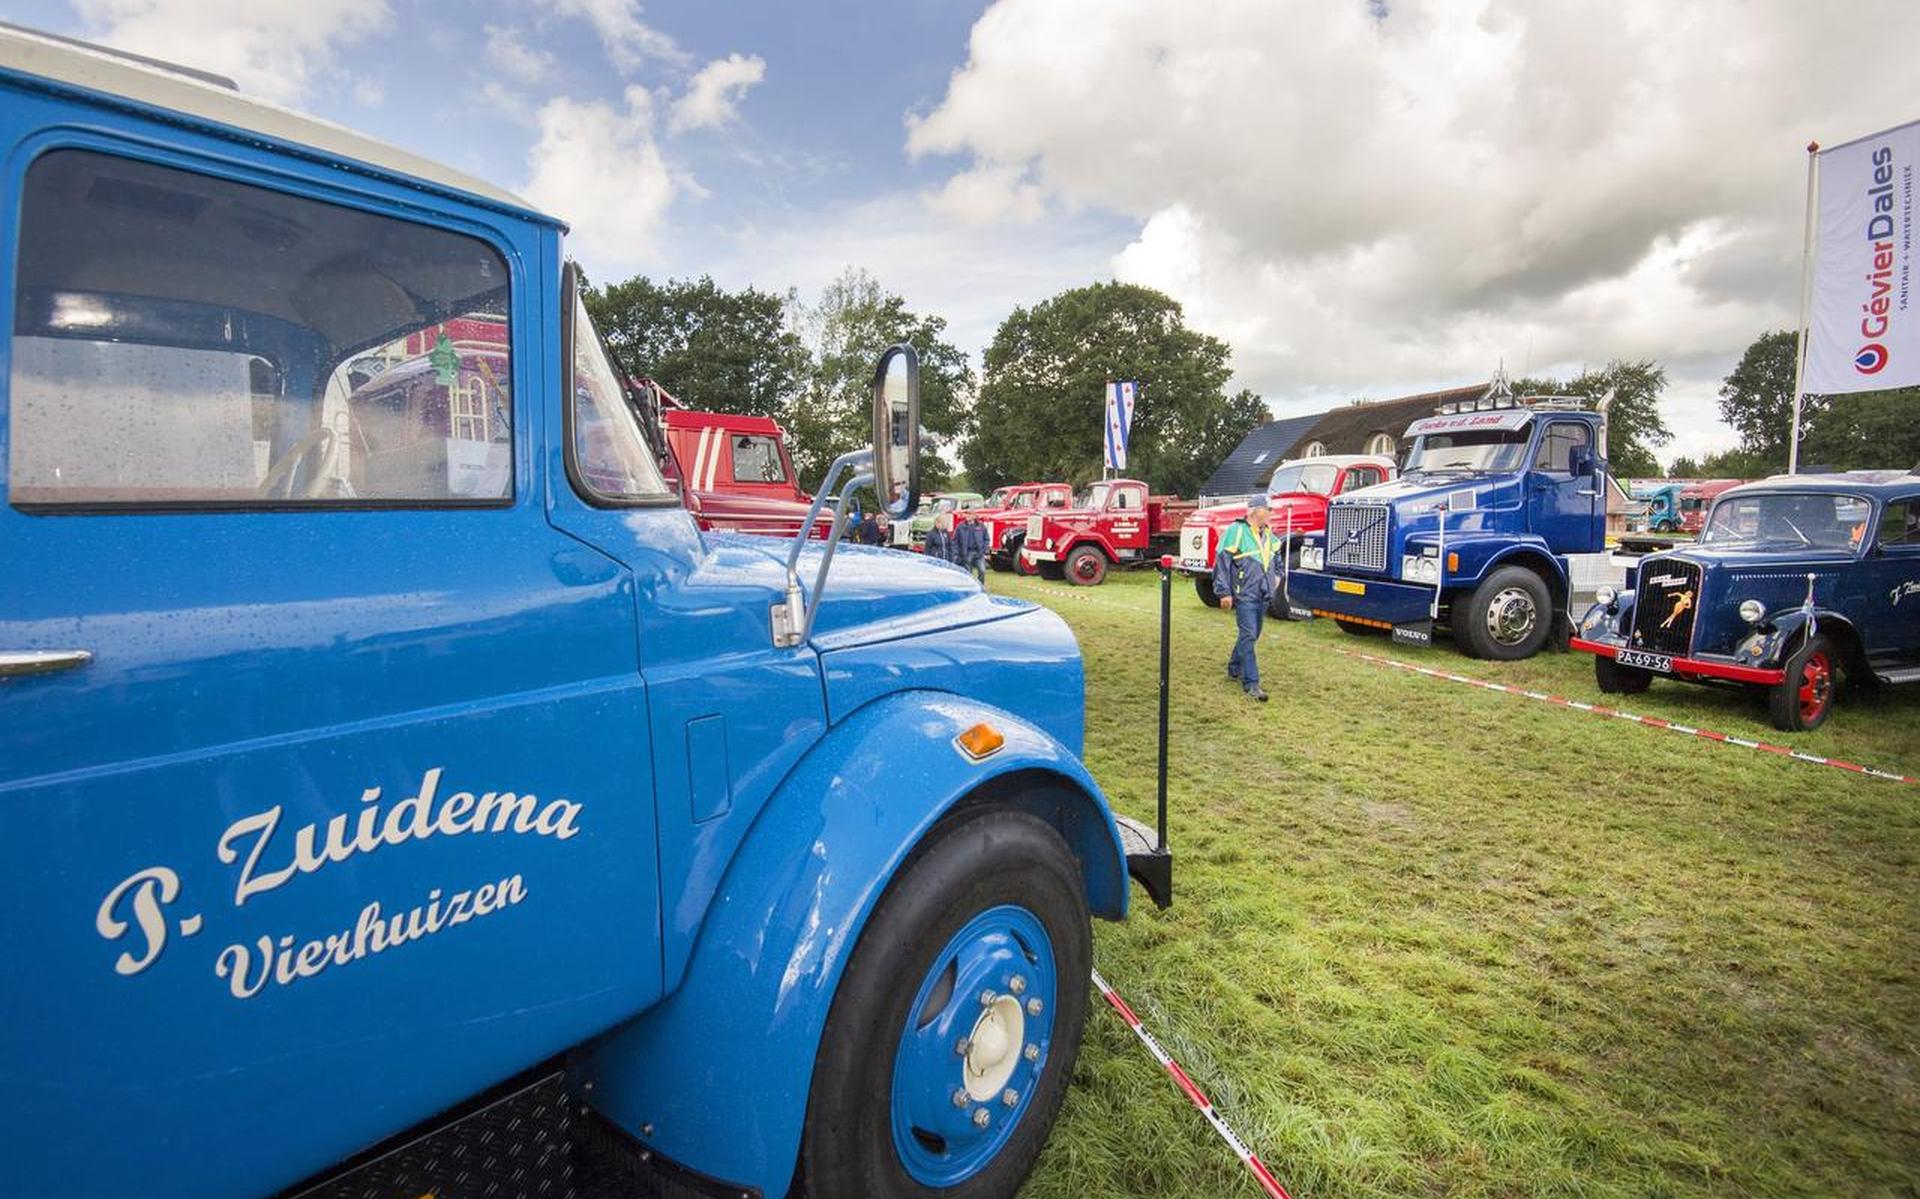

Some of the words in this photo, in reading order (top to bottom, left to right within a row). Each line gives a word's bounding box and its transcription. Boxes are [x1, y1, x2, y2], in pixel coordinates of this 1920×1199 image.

[1861, 146, 1894, 339] GévierDales
[1394, 627, 1429, 642] VOLVO
[217, 766, 584, 907] Zuidema
[215, 873, 529, 1000] Vierhuizen
